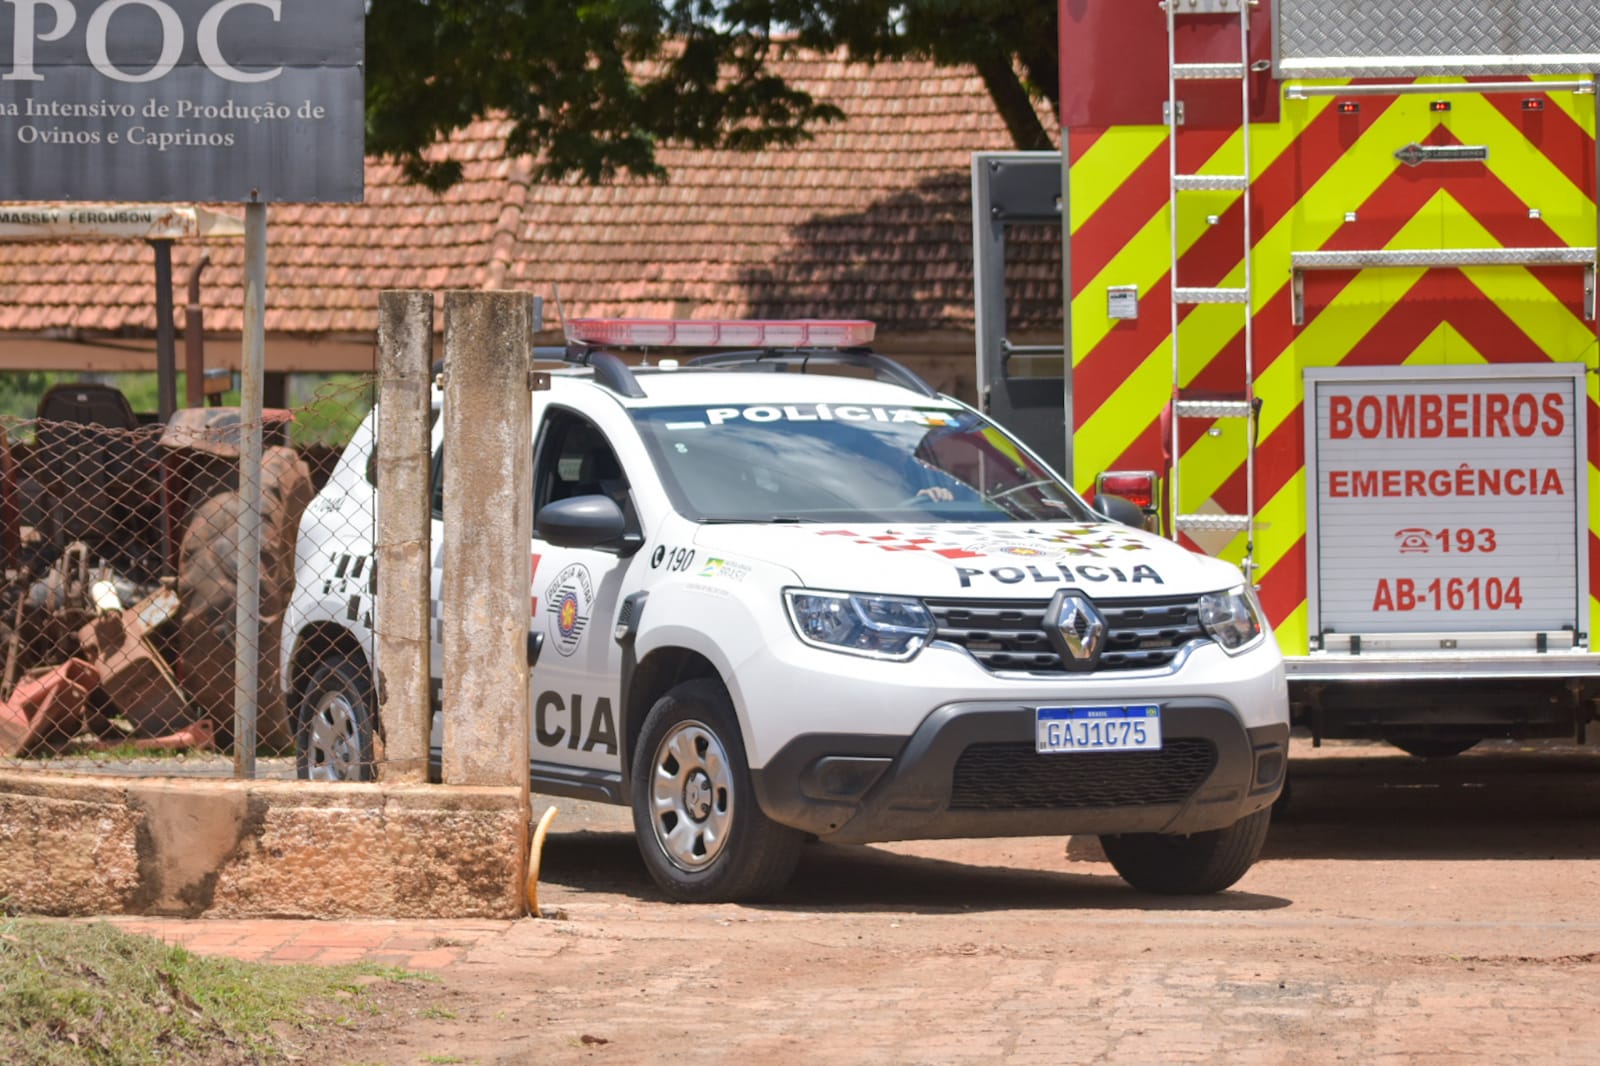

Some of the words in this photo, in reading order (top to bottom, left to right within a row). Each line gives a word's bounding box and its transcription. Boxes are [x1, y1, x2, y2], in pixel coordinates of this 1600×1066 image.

[2, 0, 283, 83] POC
[25, 98, 136, 117] Intensivo
[142, 98, 170, 118] de
[176, 100, 291, 124] Produção
[297, 100, 326, 119] de
[17, 125, 101, 144] Ovinos
[107, 131, 119, 144] e
[127, 126, 235, 151] Caprinos
[0, 212, 58, 224] MASSEY
[69, 211, 152, 224] FERGUSON
[706, 403, 929, 425] POLÍCIA
[1329, 393, 1565, 439] BOMBEIROS
[1329, 463, 1564, 497] EMERGÊNCIA
[1435, 528, 1497, 553] 193
[666, 547, 696, 572] 190
[955, 561, 1164, 588] POLÍCIA
[1372, 577, 1523, 611] AB-16104
[1047, 720, 1147, 747] GAJ1C75
